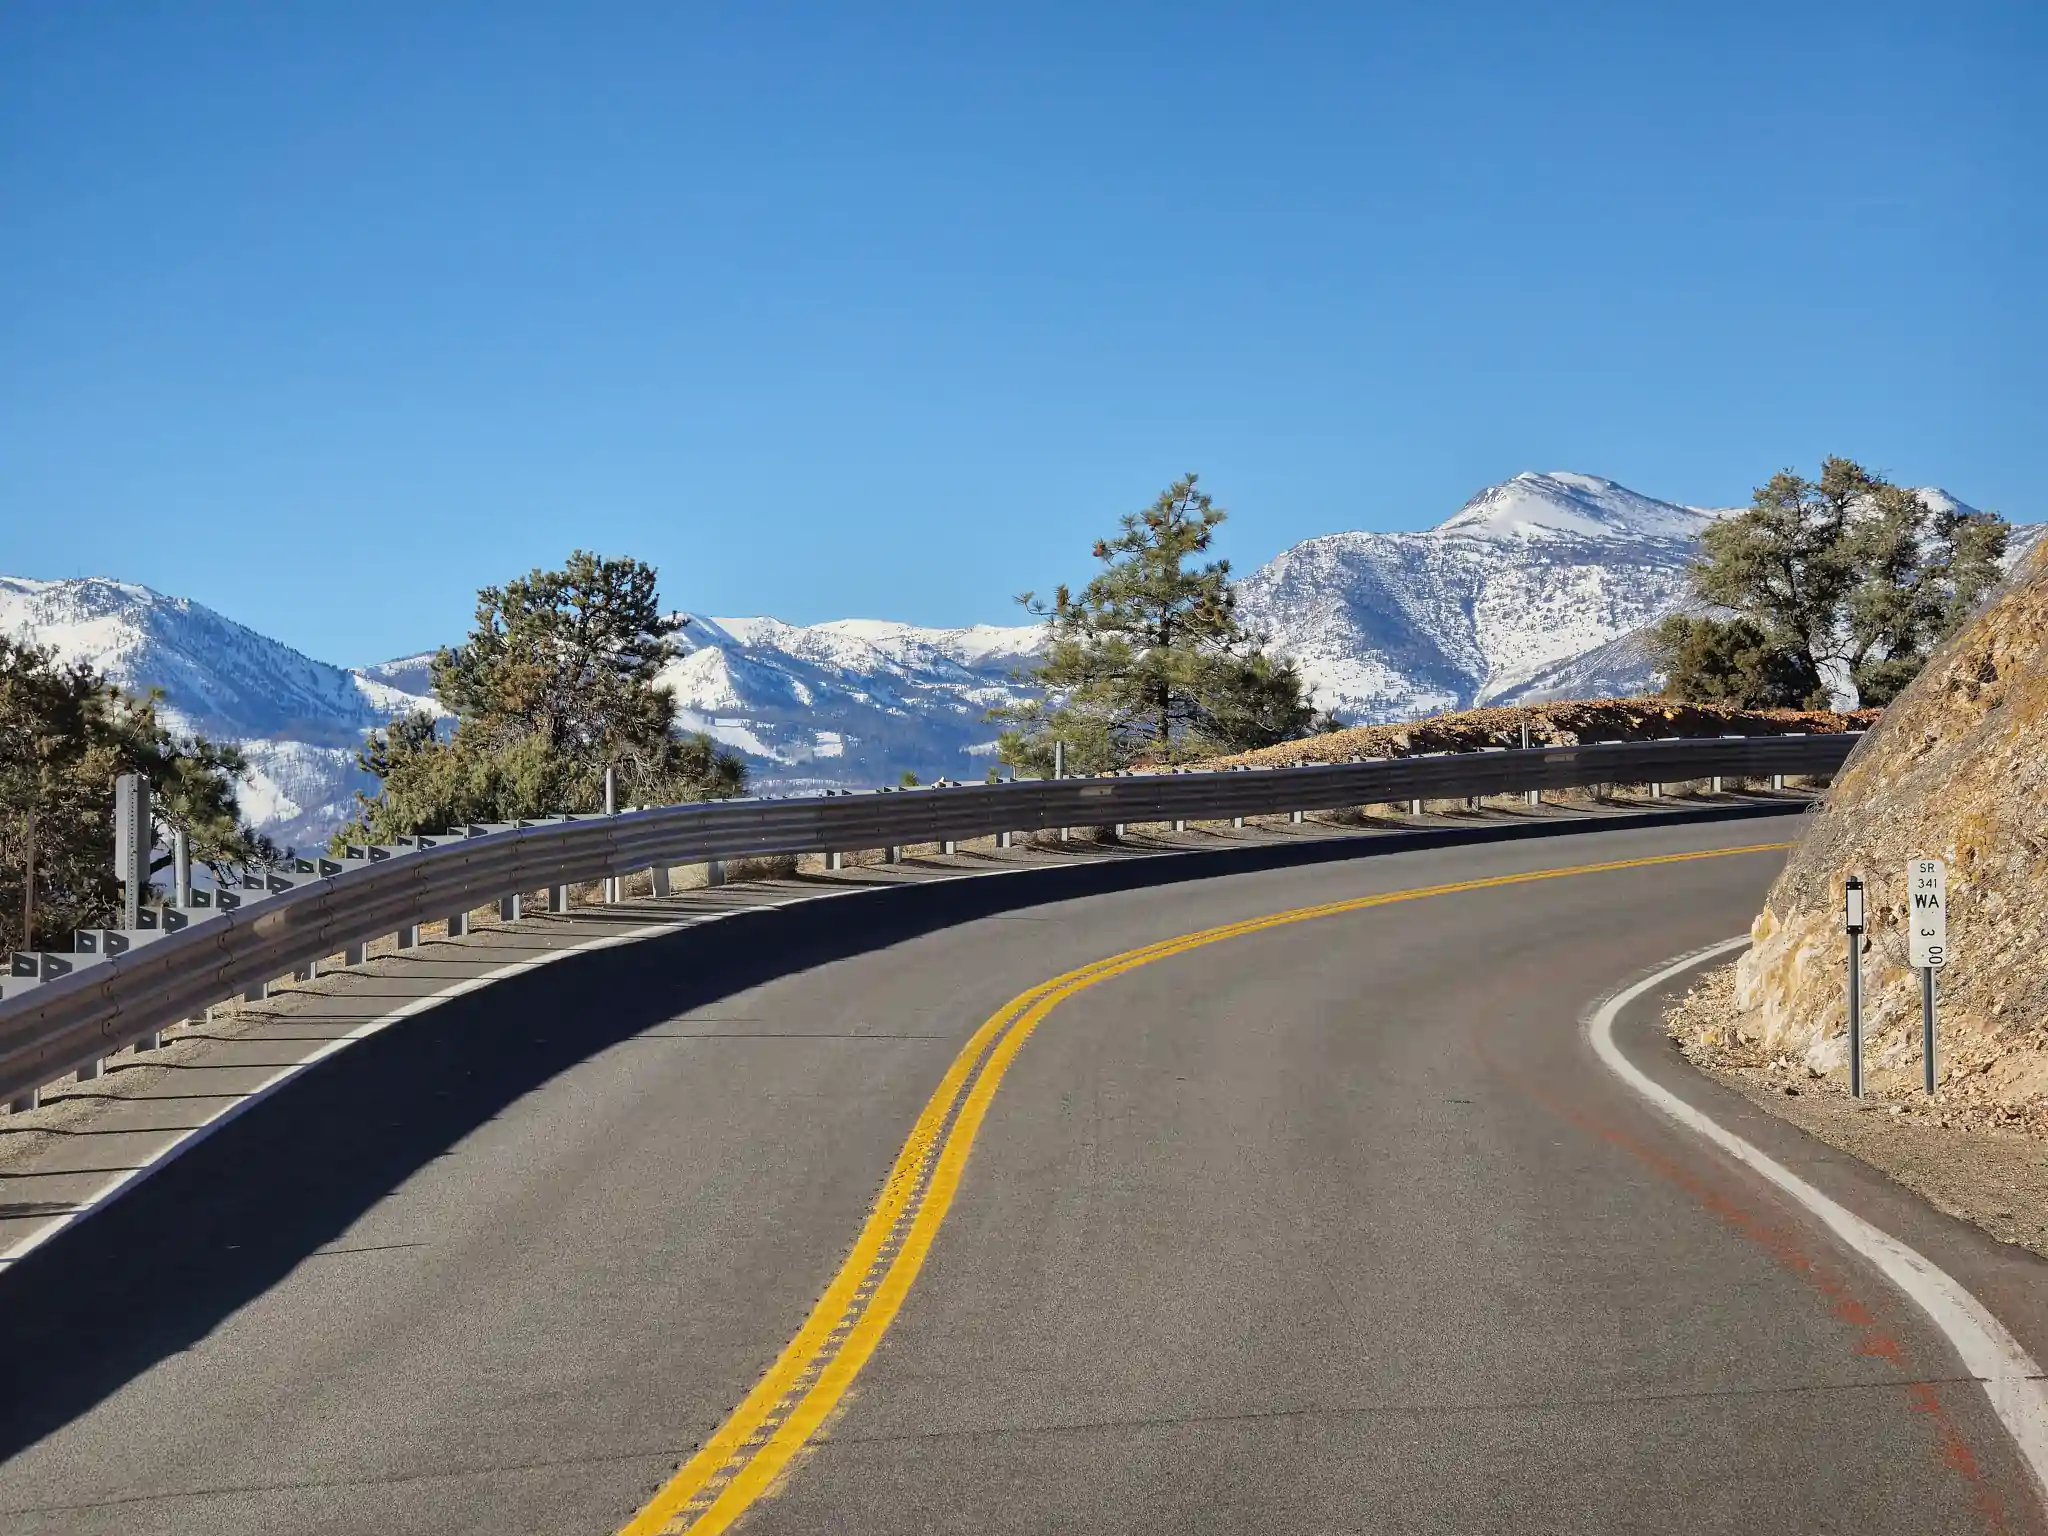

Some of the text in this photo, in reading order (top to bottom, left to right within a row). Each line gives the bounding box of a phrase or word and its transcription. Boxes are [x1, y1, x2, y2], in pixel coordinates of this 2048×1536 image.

[1920, 863, 1935, 873] SR
[1918, 879, 1937, 889] 341
[1915, 894, 1939, 909] WA
[1921, 928, 1935, 937] 3
